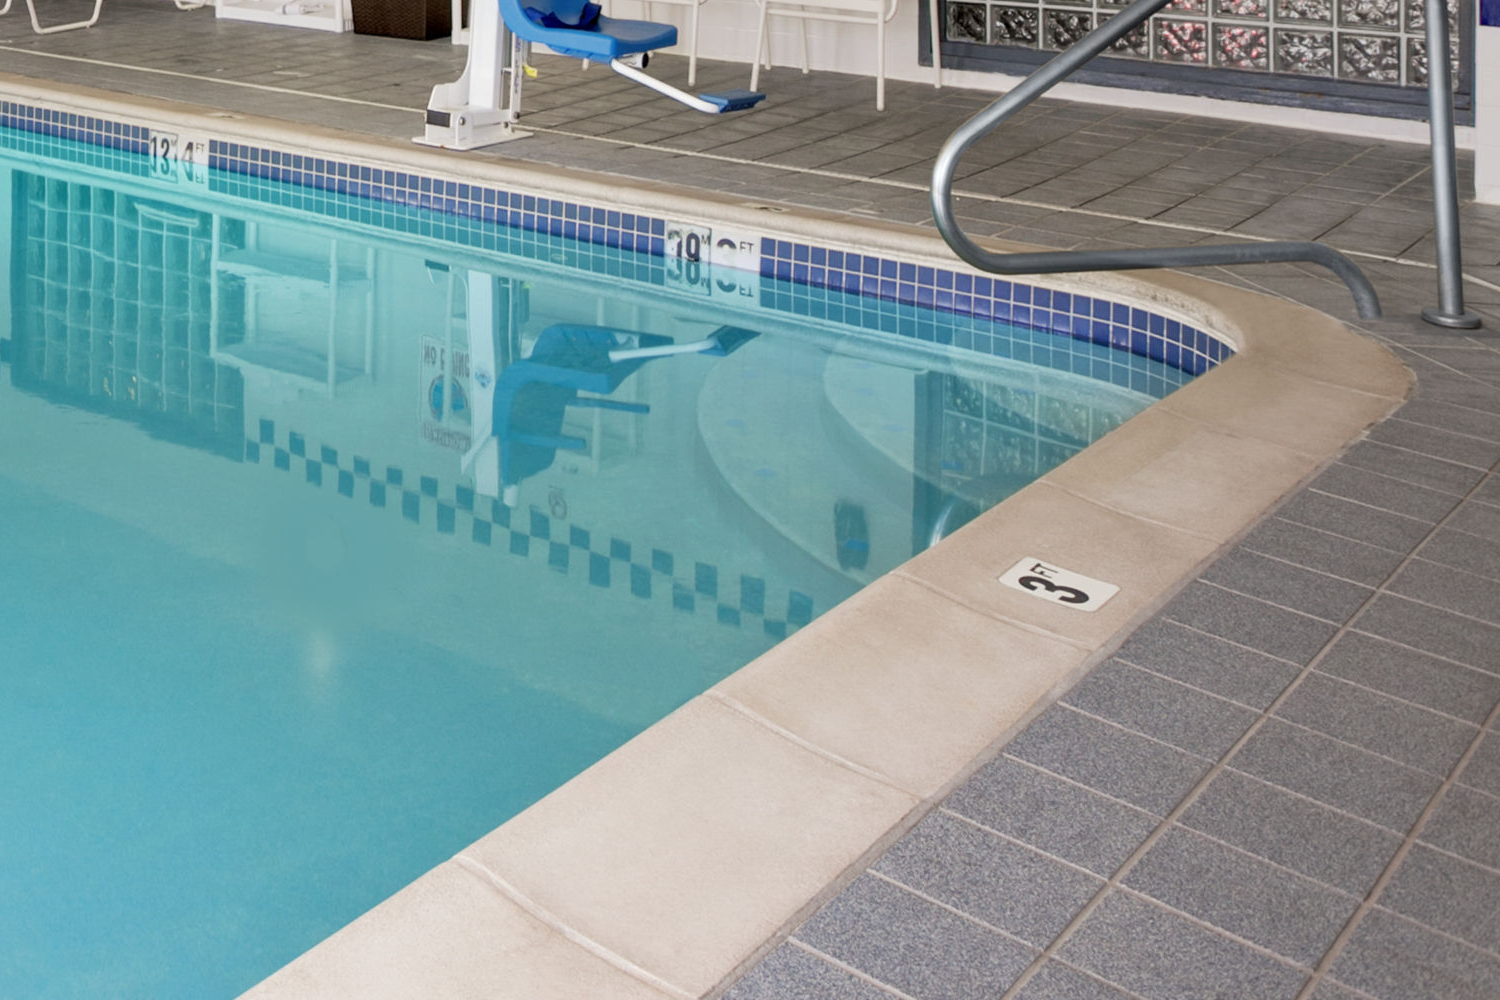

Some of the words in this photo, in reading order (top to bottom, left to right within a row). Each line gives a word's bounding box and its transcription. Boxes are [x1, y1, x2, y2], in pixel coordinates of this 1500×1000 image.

[739, 241, 755, 255] FT
[1029, 562, 1059, 579] FT
[1018, 576, 1090, 604] 3
